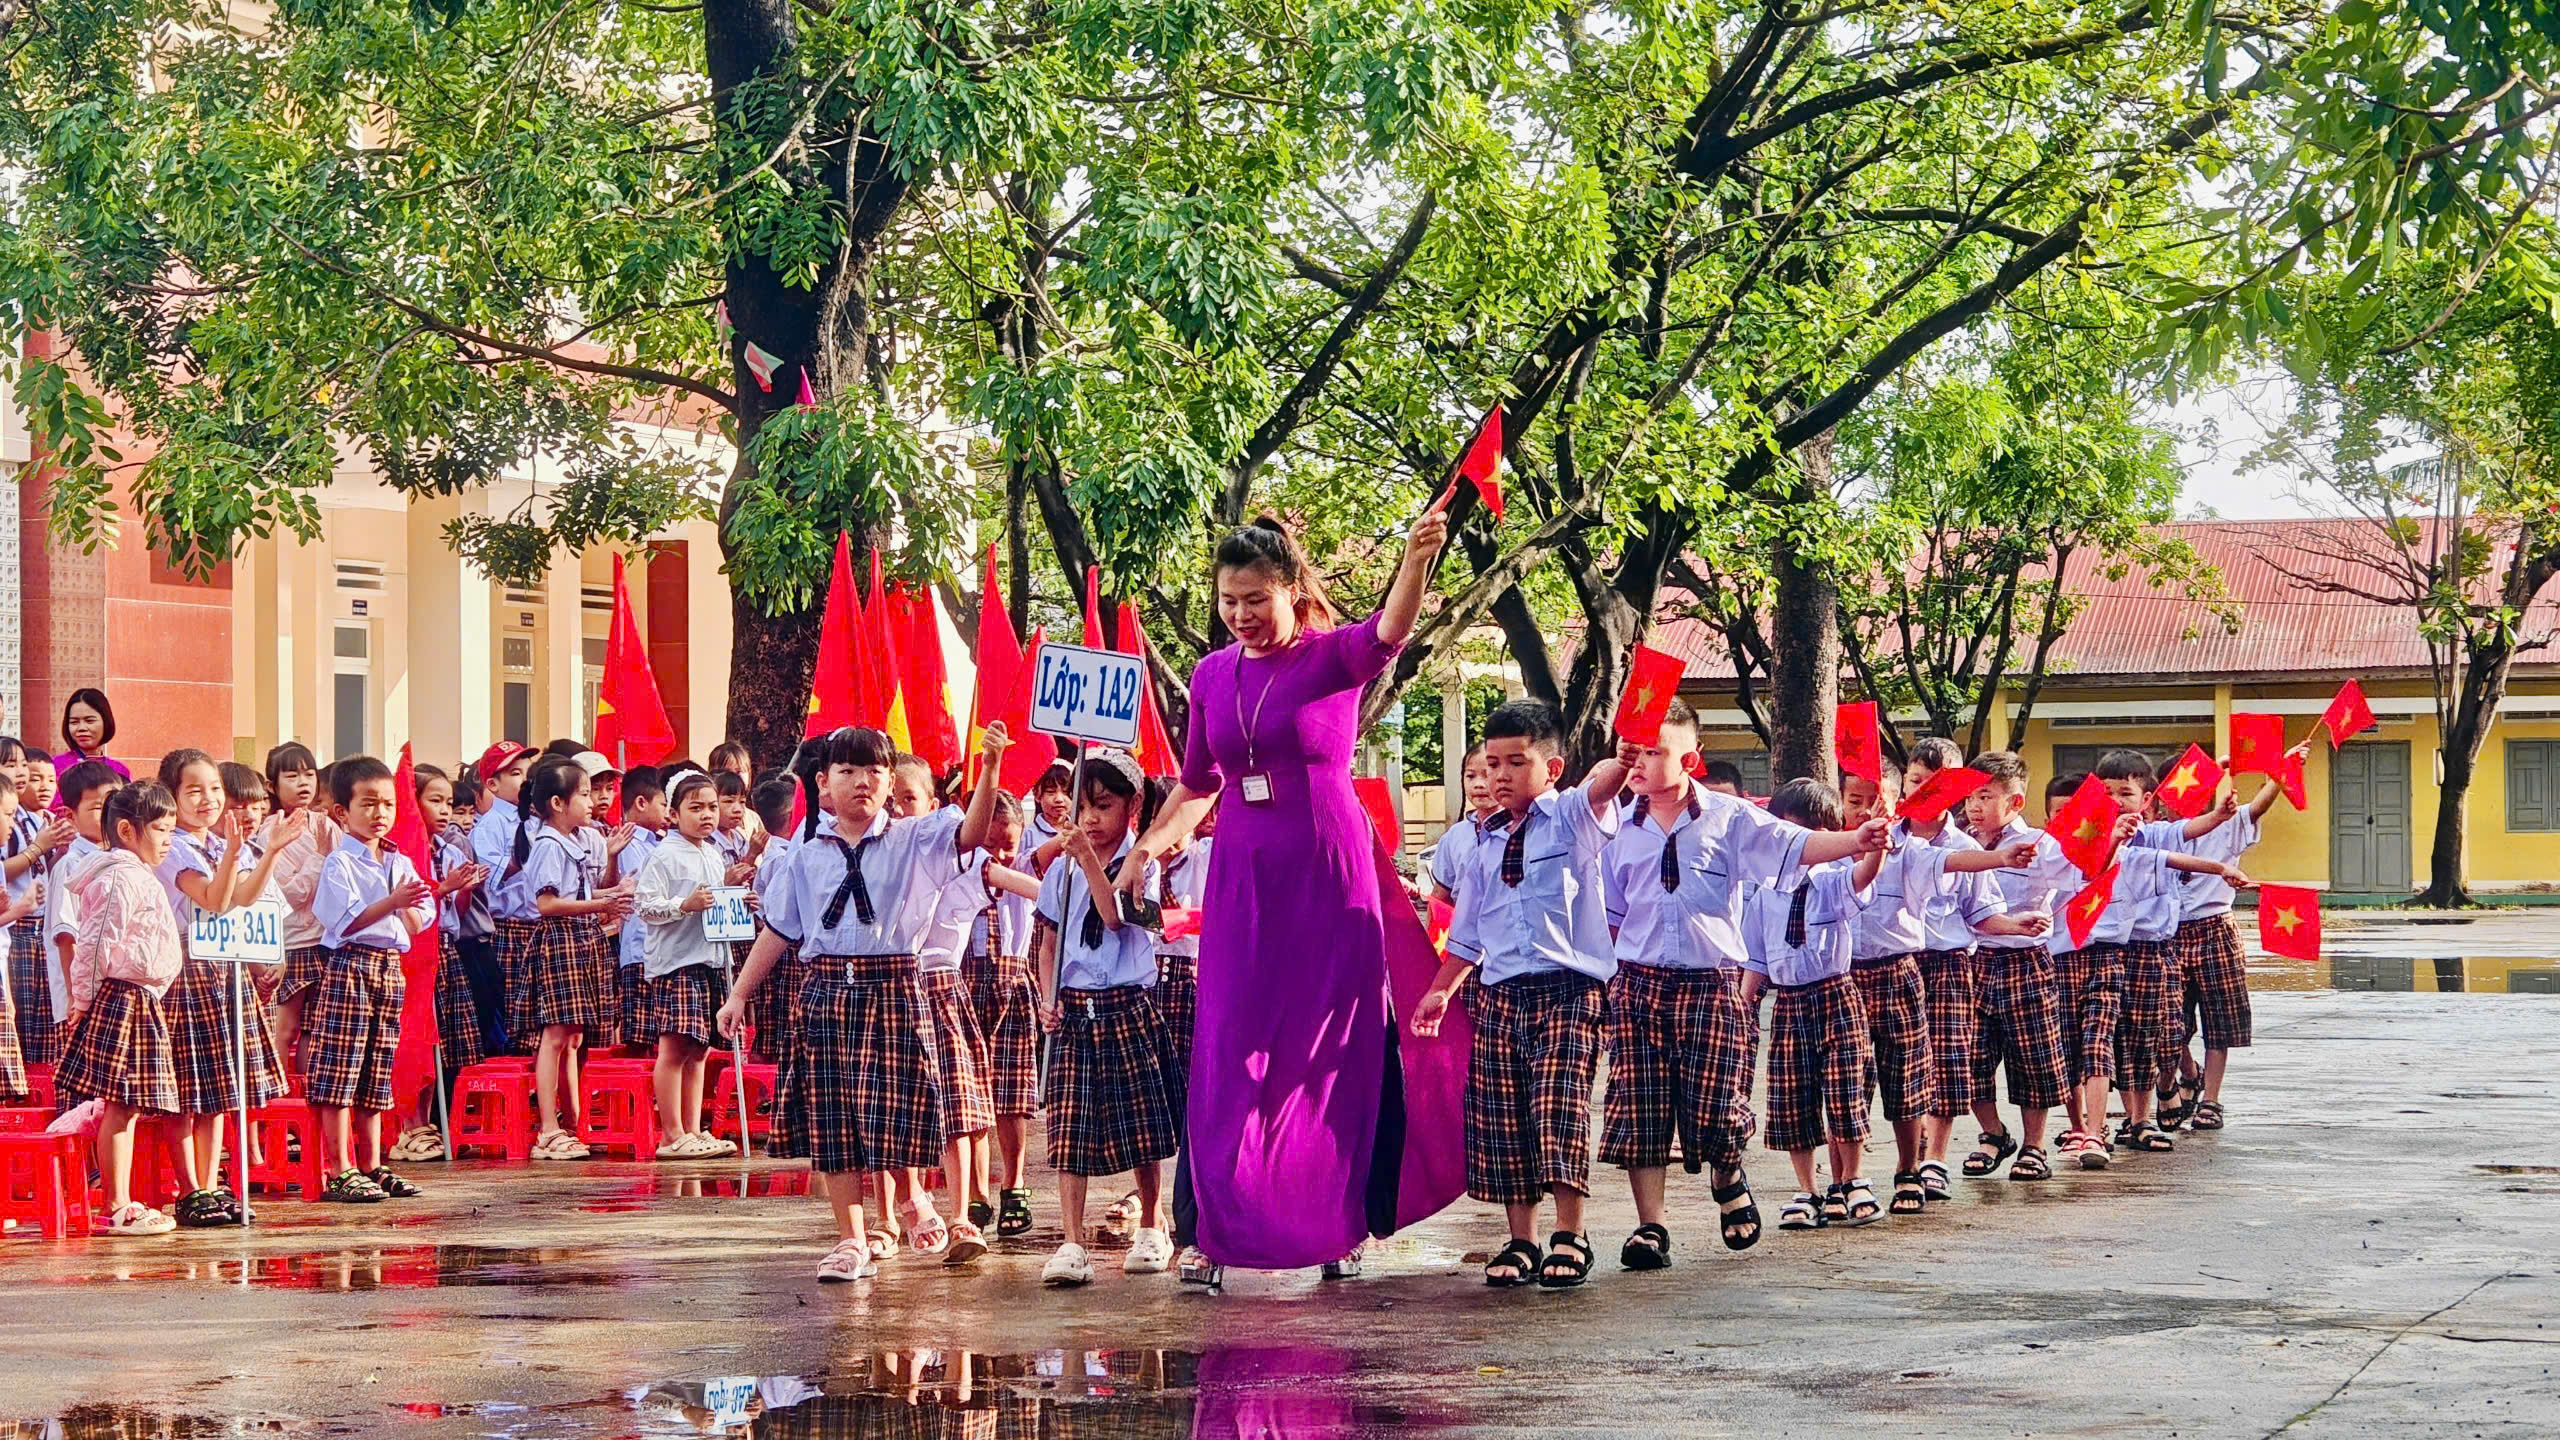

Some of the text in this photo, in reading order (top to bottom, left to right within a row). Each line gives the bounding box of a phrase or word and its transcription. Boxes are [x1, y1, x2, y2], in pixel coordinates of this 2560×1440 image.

[1039, 655, 1137, 726] Lớp: 1A2
[195, 908, 277, 952] Lớp: 3A1
